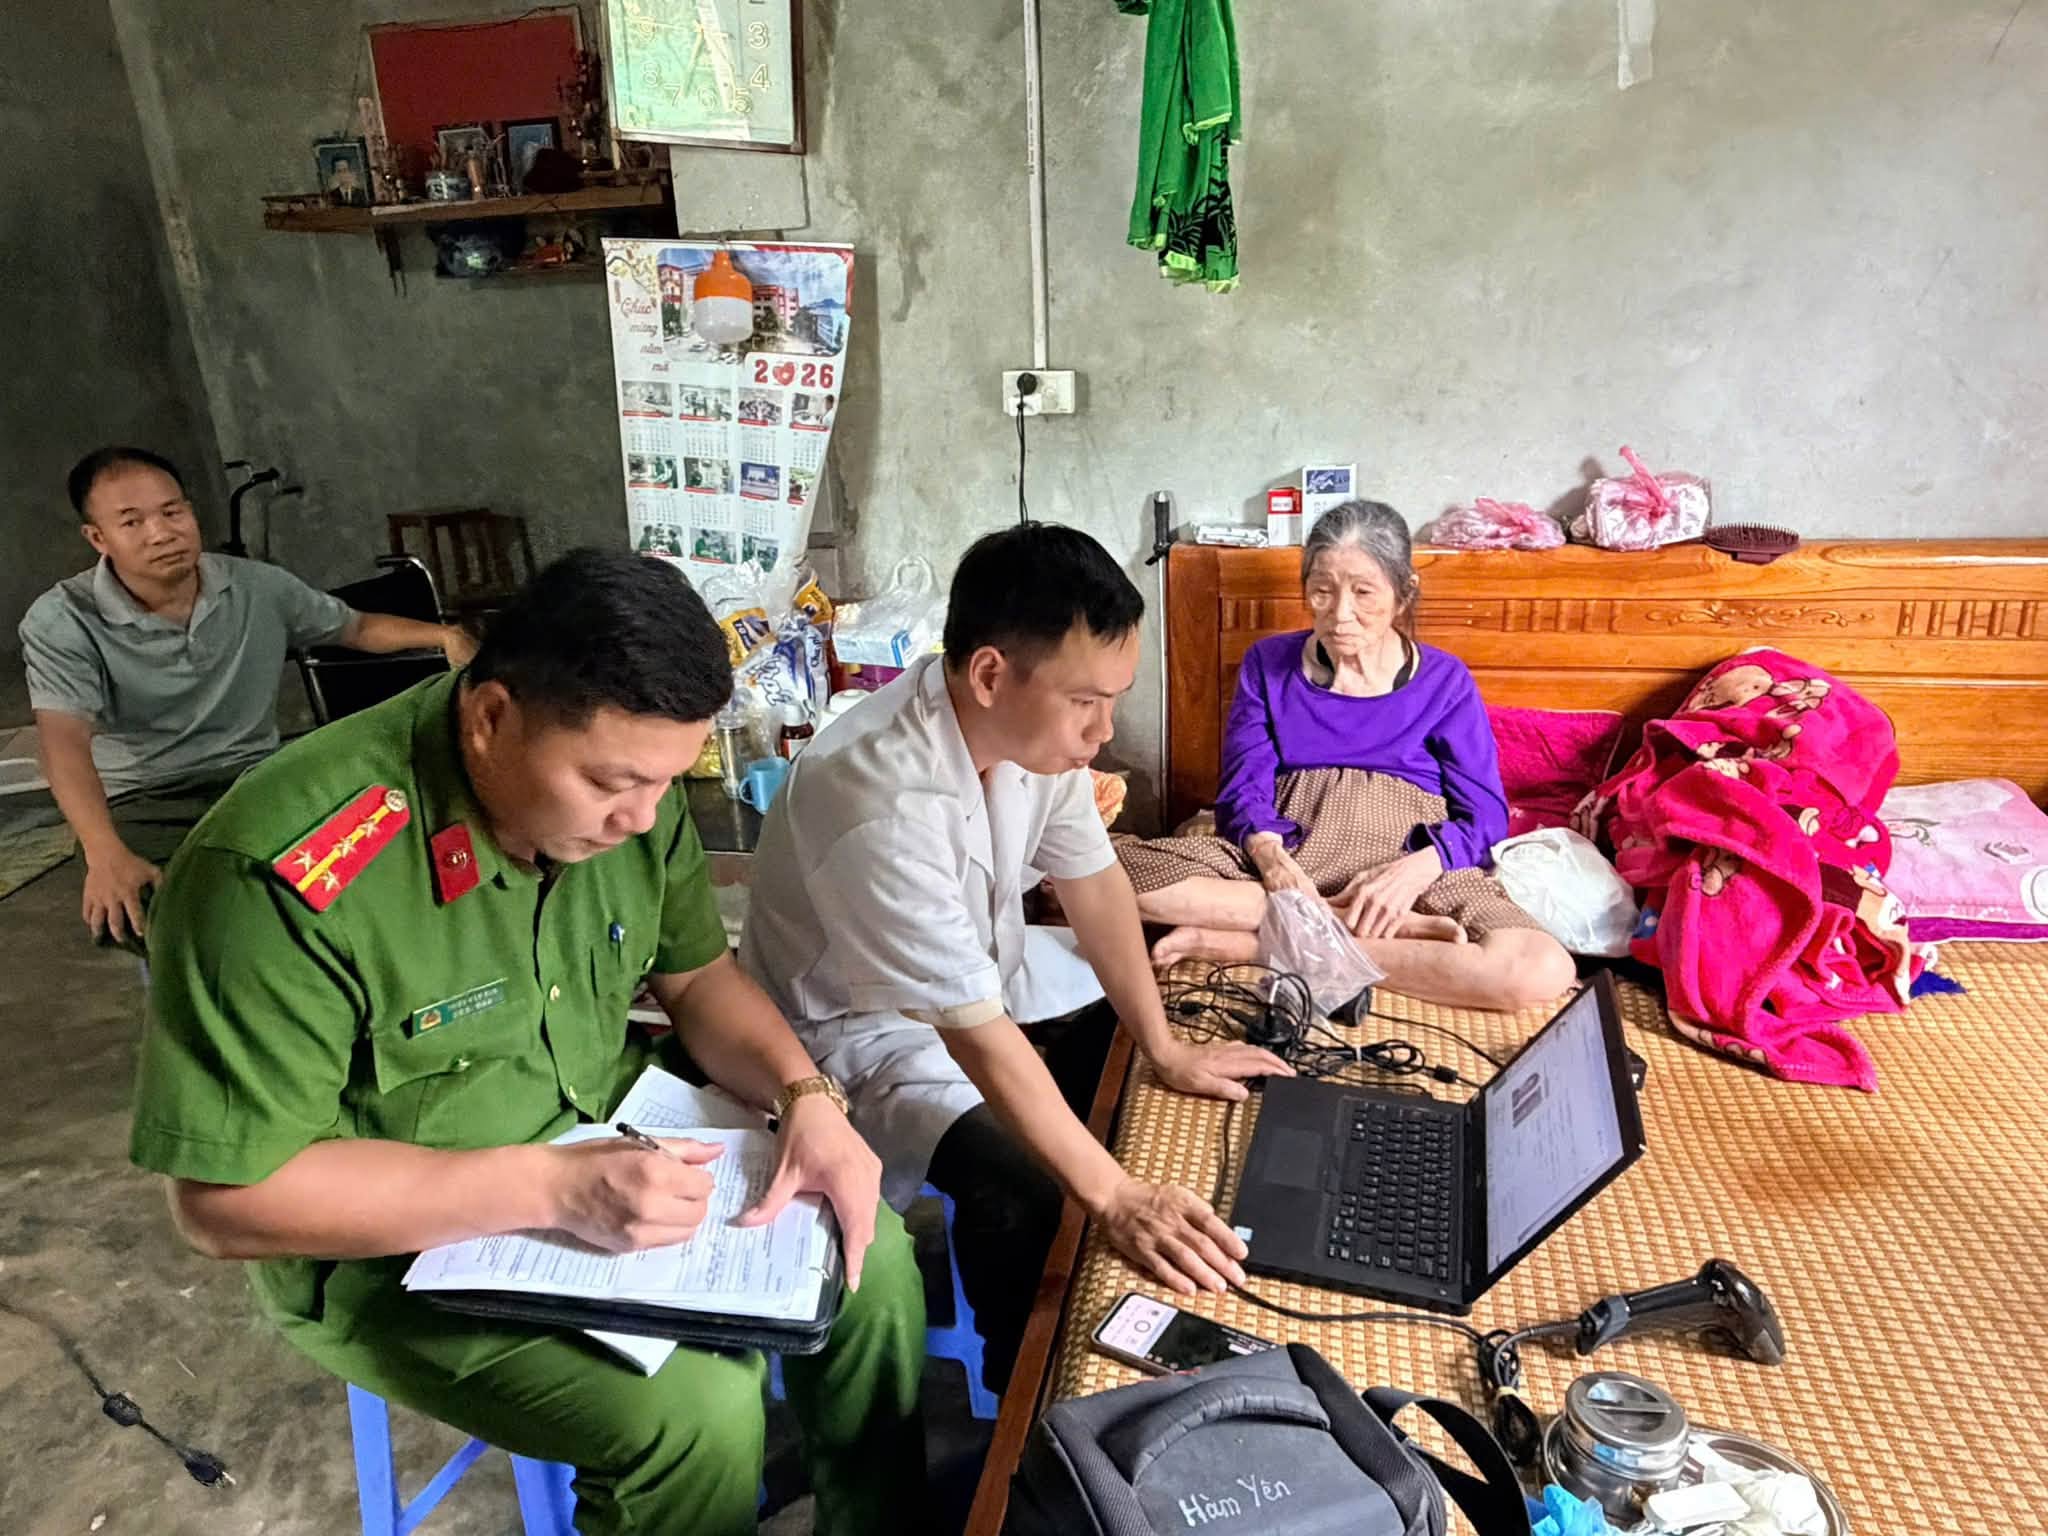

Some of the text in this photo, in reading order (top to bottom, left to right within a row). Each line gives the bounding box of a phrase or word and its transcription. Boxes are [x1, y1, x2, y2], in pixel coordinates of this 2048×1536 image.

[748, 21, 770, 49] 3
[642, 61, 662, 88] 8
[750, 63, 773, 93] 4
[663, 82, 682, 107] 7
[1178, 1474, 1291, 1527] Hàm Yên
